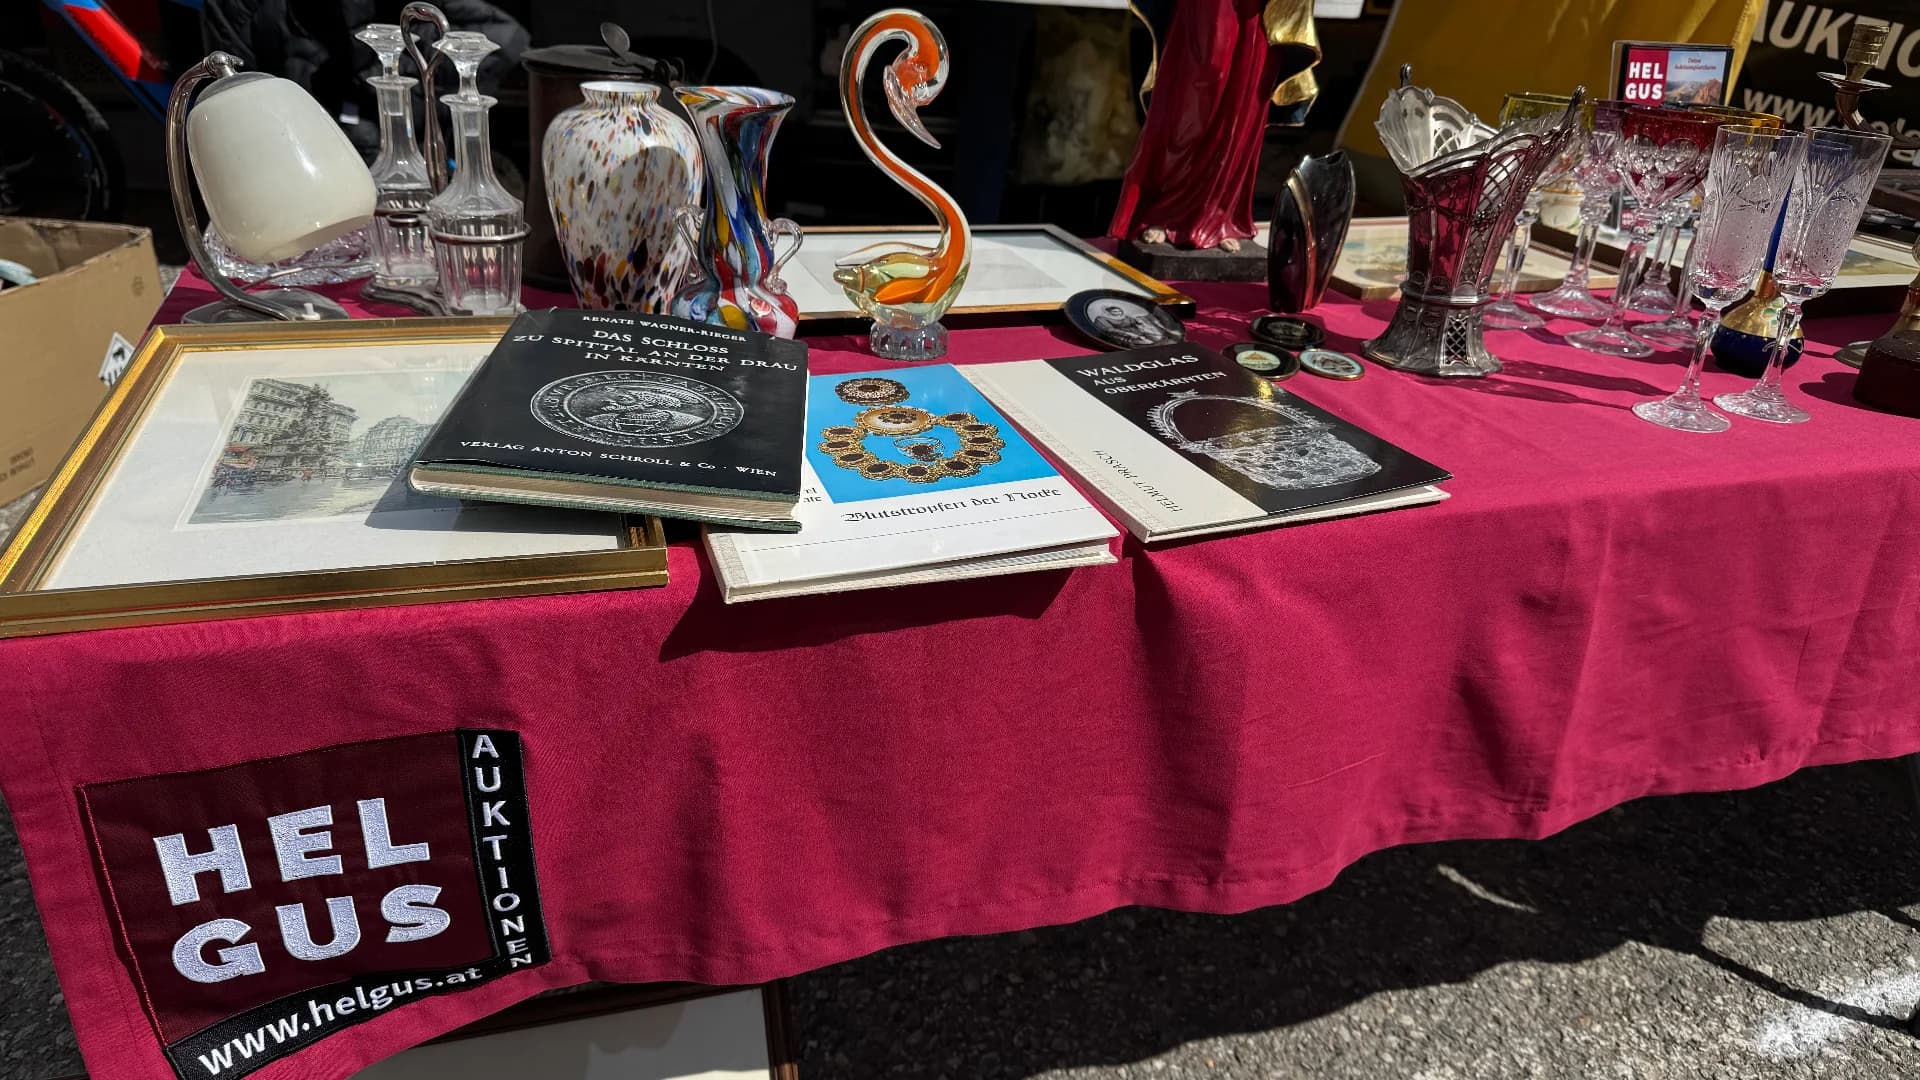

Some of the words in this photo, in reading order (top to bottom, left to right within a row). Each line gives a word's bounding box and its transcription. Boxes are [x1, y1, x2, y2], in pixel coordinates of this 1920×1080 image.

[1628, 61, 1664, 79] HEL
[1625, 82, 1663, 100] GUS
[583, 315, 635, 326] RENATE
[639, 320, 747, 342] WAGNER-RIEGER
[592, 330, 633, 343] DAS
[640, 336, 729, 354] SCHLOSS
[512, 334, 545, 342] ZU
[551, 337, 640, 354] SPITTAL
[648, 350, 680, 359] AN
[688, 354, 731, 364] DER
[740, 359, 798, 371] DRAU
[584, 352, 611, 360] IN
[619, 355, 725, 372] KÄRNTEN
[1076, 355, 1200, 378] WALDGLAS
[1093, 376, 1128, 387] AUS
[460, 441, 526, 451] VERLAG
[530, 446, 593, 458] ANTON
[599, 453, 674, 466] SCHROLL
[735, 466, 778, 477] WIEN
[1092, 450, 1138, 479] PRASCH
[840, 501, 967, 522] Blutstropfen
[970, 496, 1001, 506] der
[1133, 481, 1183, 512] HELMUT
[153, 797, 431, 906] HEL
[471, 734, 533, 969] AUKTIONEN
[171, 884, 452, 984] GUS
[198, 966, 484, 1077] www.helgus.at
